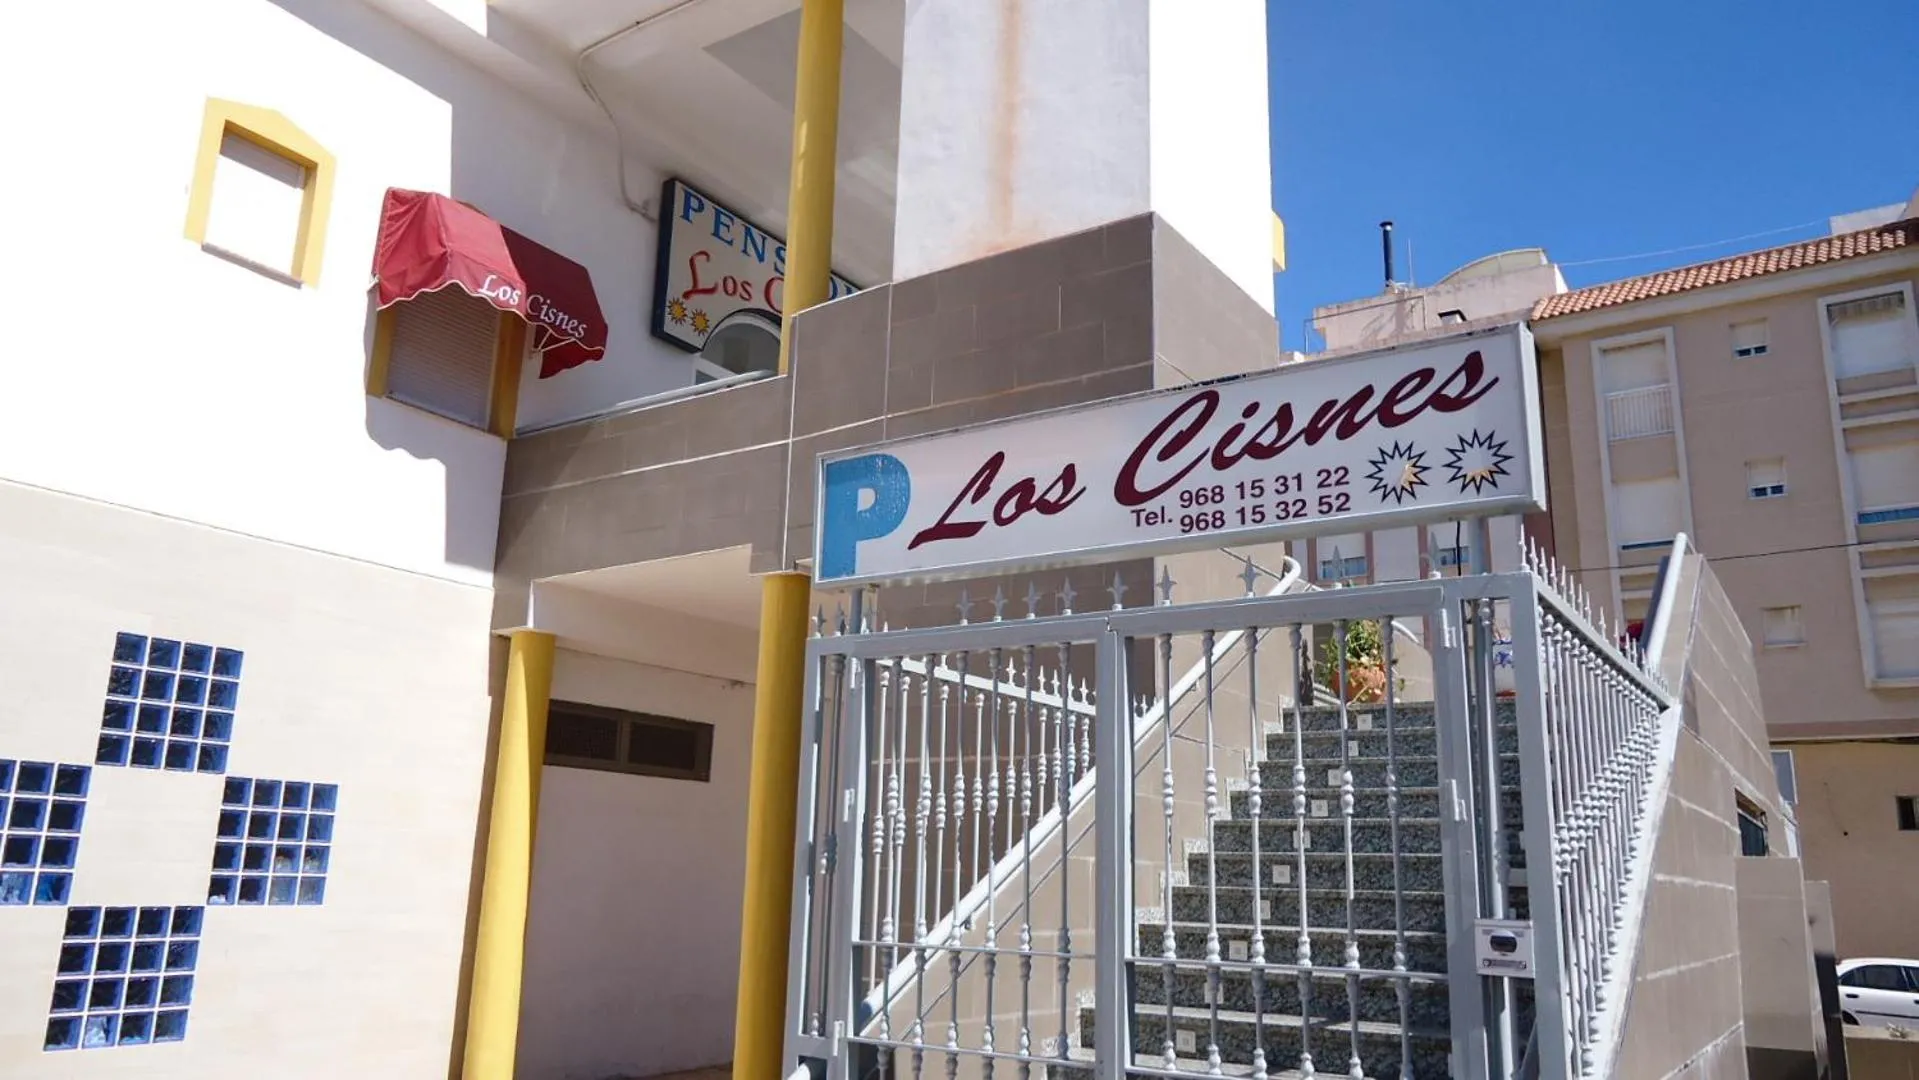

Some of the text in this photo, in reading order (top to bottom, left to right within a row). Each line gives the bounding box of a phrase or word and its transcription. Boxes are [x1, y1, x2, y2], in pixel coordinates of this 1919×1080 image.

[682, 250, 753, 302] Los
[478, 274, 588, 338] Los Cisnes
[821, 349, 1499, 580] P Los Cisnes
[1179, 465, 1350, 509] 968 15 31 22
[1130, 505, 1173, 528] Tel.
[1180, 491, 1352, 533] 968 15 32 52
